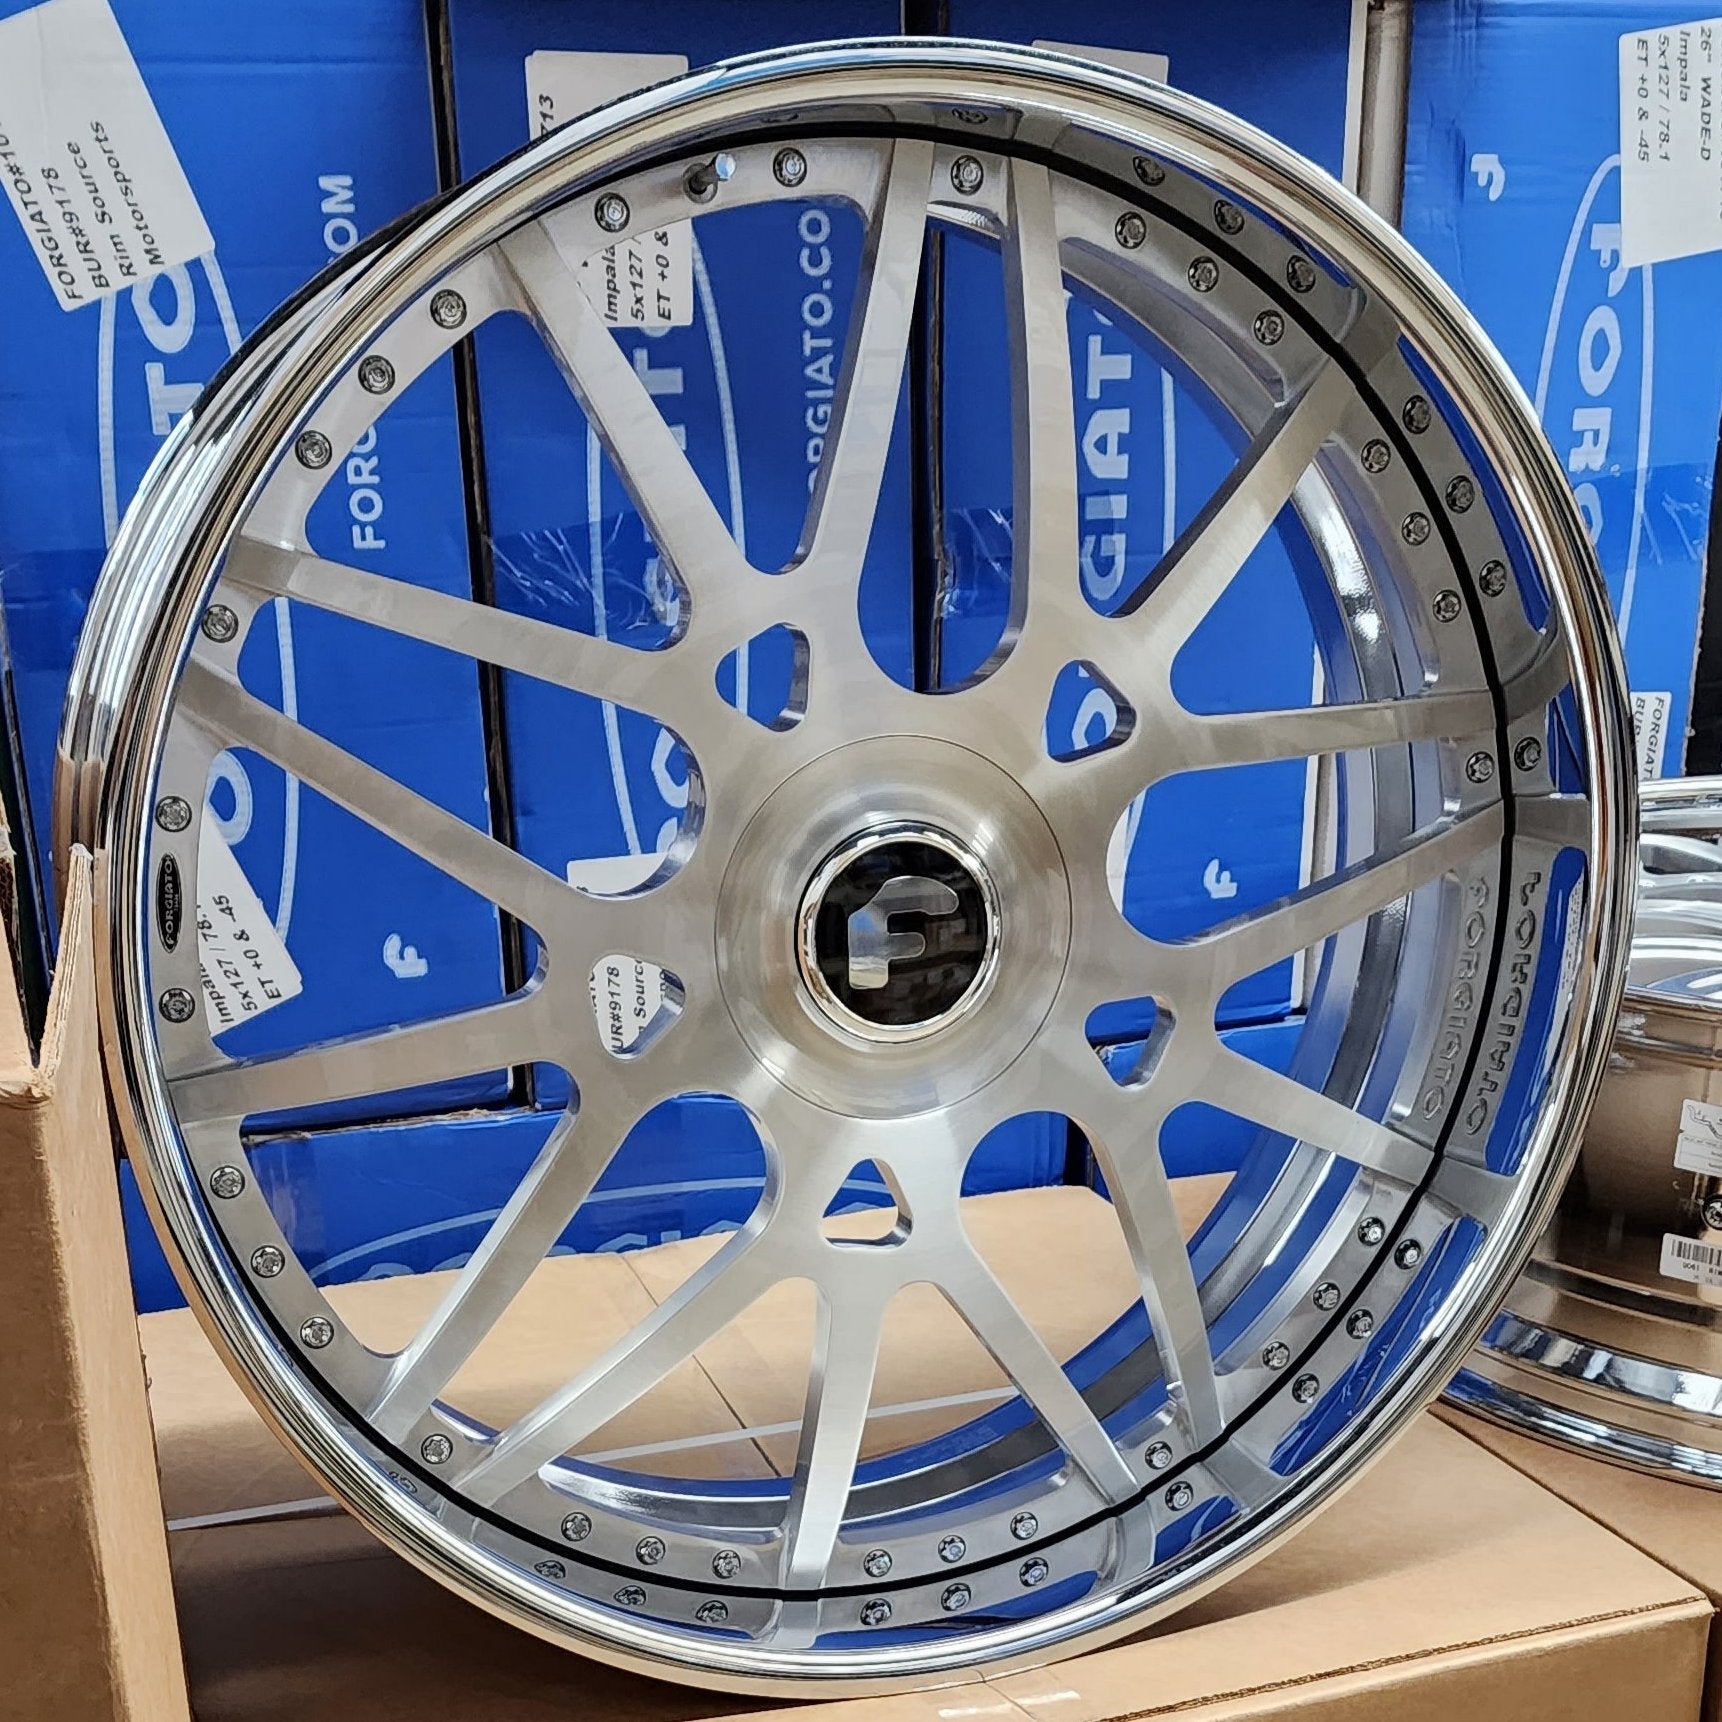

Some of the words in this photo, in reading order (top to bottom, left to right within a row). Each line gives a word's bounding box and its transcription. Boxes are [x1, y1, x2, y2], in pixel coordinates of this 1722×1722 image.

[1636, 38, 1649, 67] ET
[1657, 33, 1670, 100] 5x127
[1677, 30, 1691, 102] Impala
[1636, 73, 1649, 99] +0
[1637, 106, 1649, 121] &
[1700, 77, 1712, 161] WADE-D
[1637, 129, 1650, 162] -45
[1658, 118, 1671, 162] 78.1
[67, 141, 113, 224] Source
[90, 121, 165, 265] Motorsports
[0, 122, 83, 300] FORGIATO#10
[41, 167, 110, 288] BUR#9178
[110, 233, 138, 277] Rim
[653, 231, 669, 247] &
[628, 249, 645, 322] 5x127
[655, 254, 670, 281] +0
[656, 288, 672, 321] ET
[1643, 697, 1665, 779] FORGIAT
[163, 856, 176, 947] FORGIATO
[212, 895, 237, 922] -45
[233, 929, 250, 942] &
[243, 949, 264, 970] +0
[216, 957, 258, 1012] 5x127
[257, 976, 283, 1000] ET
[1423, 876, 1490, 1121] FORGIATO
